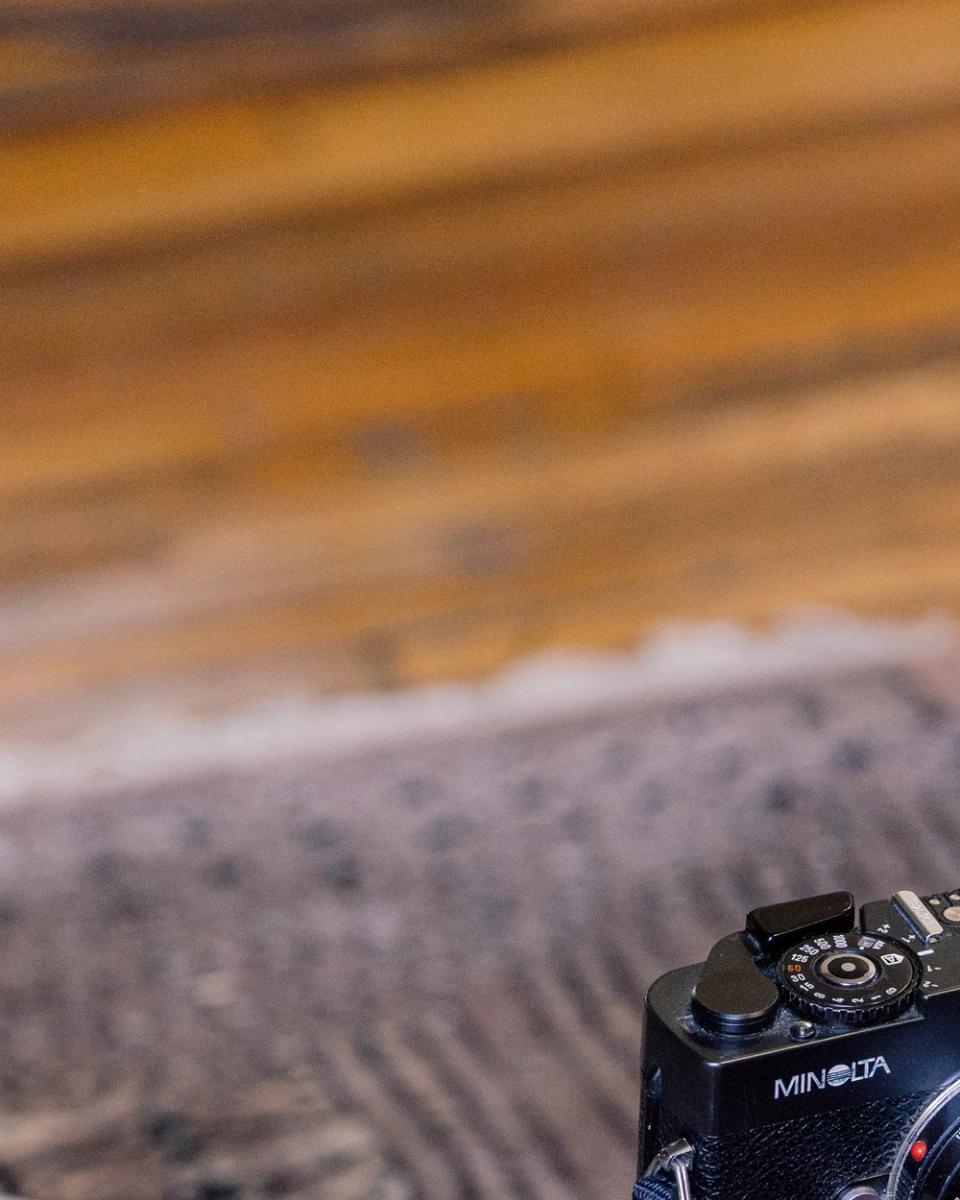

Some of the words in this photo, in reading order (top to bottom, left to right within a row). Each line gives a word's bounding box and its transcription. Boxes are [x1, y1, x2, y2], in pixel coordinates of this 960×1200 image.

[791, 953, 808, 963] 125
[790, 974, 806, 983] 30
[800, 981, 815, 992] 15
[774, 1055, 891, 1099] MINOLTA
